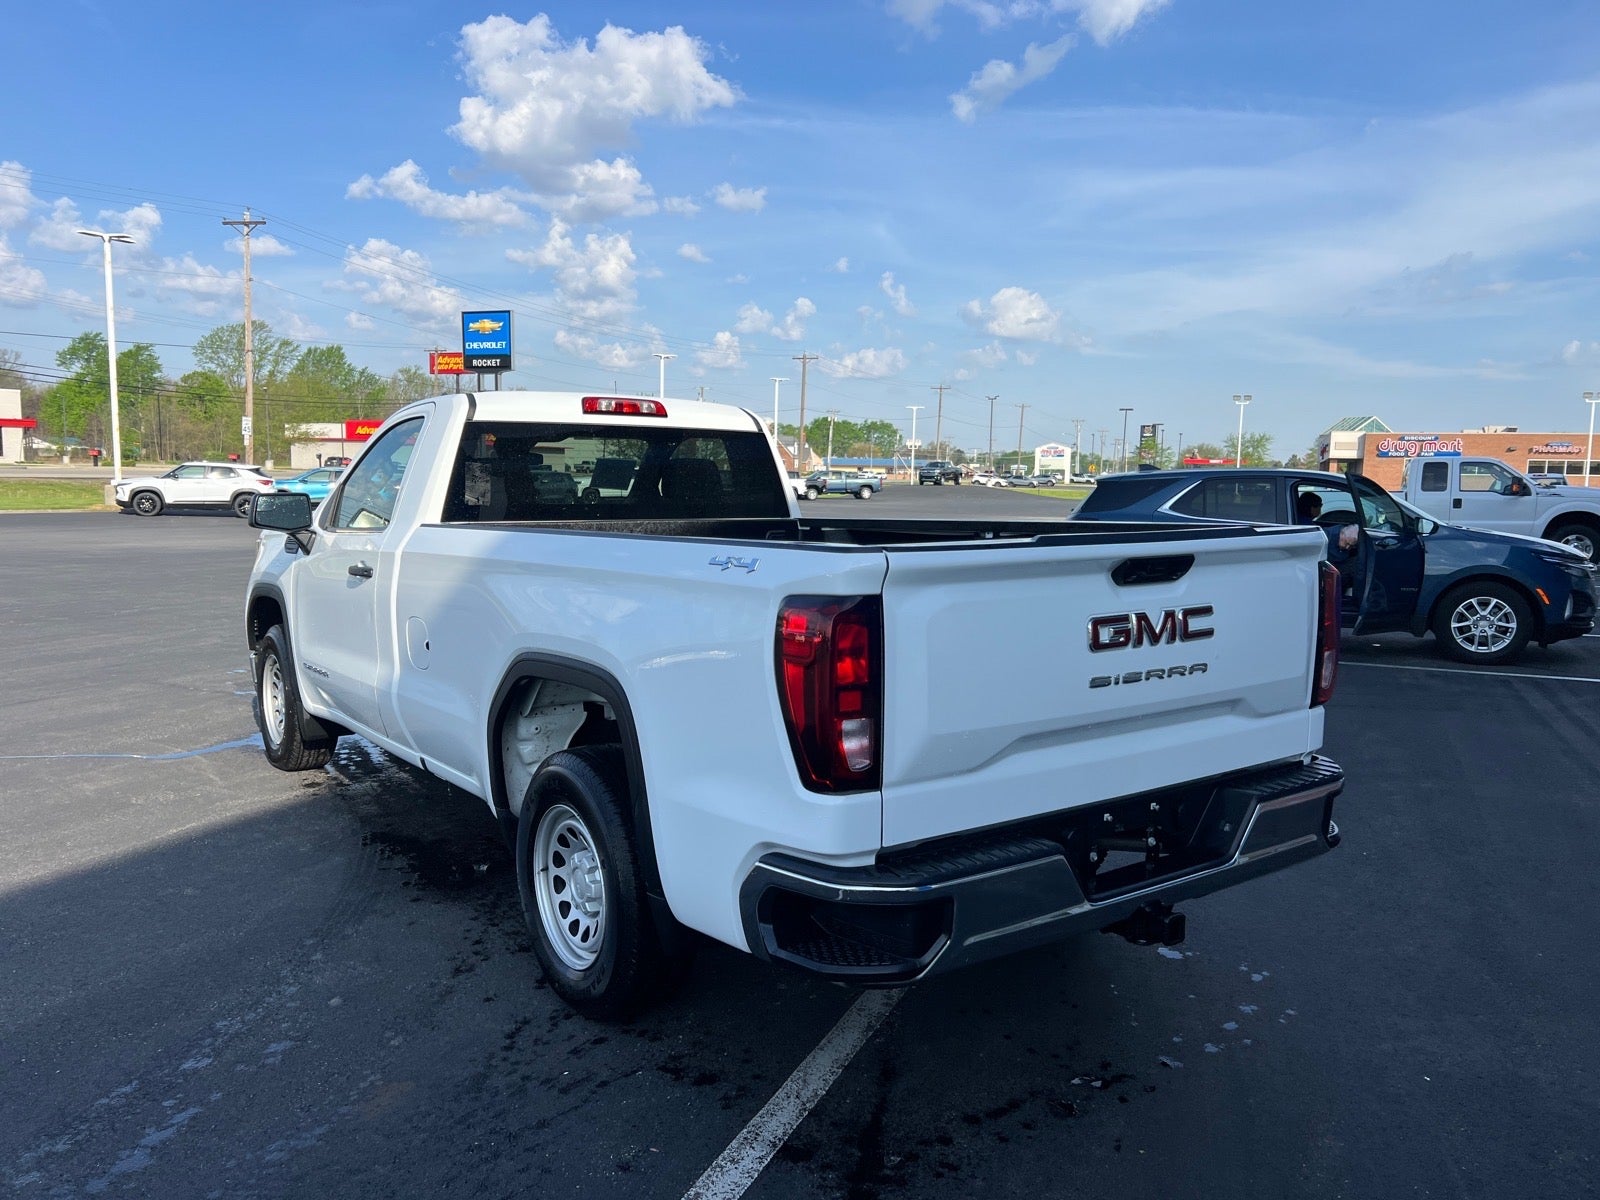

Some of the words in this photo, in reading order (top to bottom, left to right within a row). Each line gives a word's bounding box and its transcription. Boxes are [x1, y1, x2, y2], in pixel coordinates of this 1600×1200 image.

[466, 341, 507, 349] CHEVROLET
[472, 359, 501, 367] ROCKET
[1379, 438, 1418, 457] drug
[1422, 438, 1463, 452] mart
[1088, 604, 1215, 654] GMC
[1089, 663, 1208, 689] SIERRA
